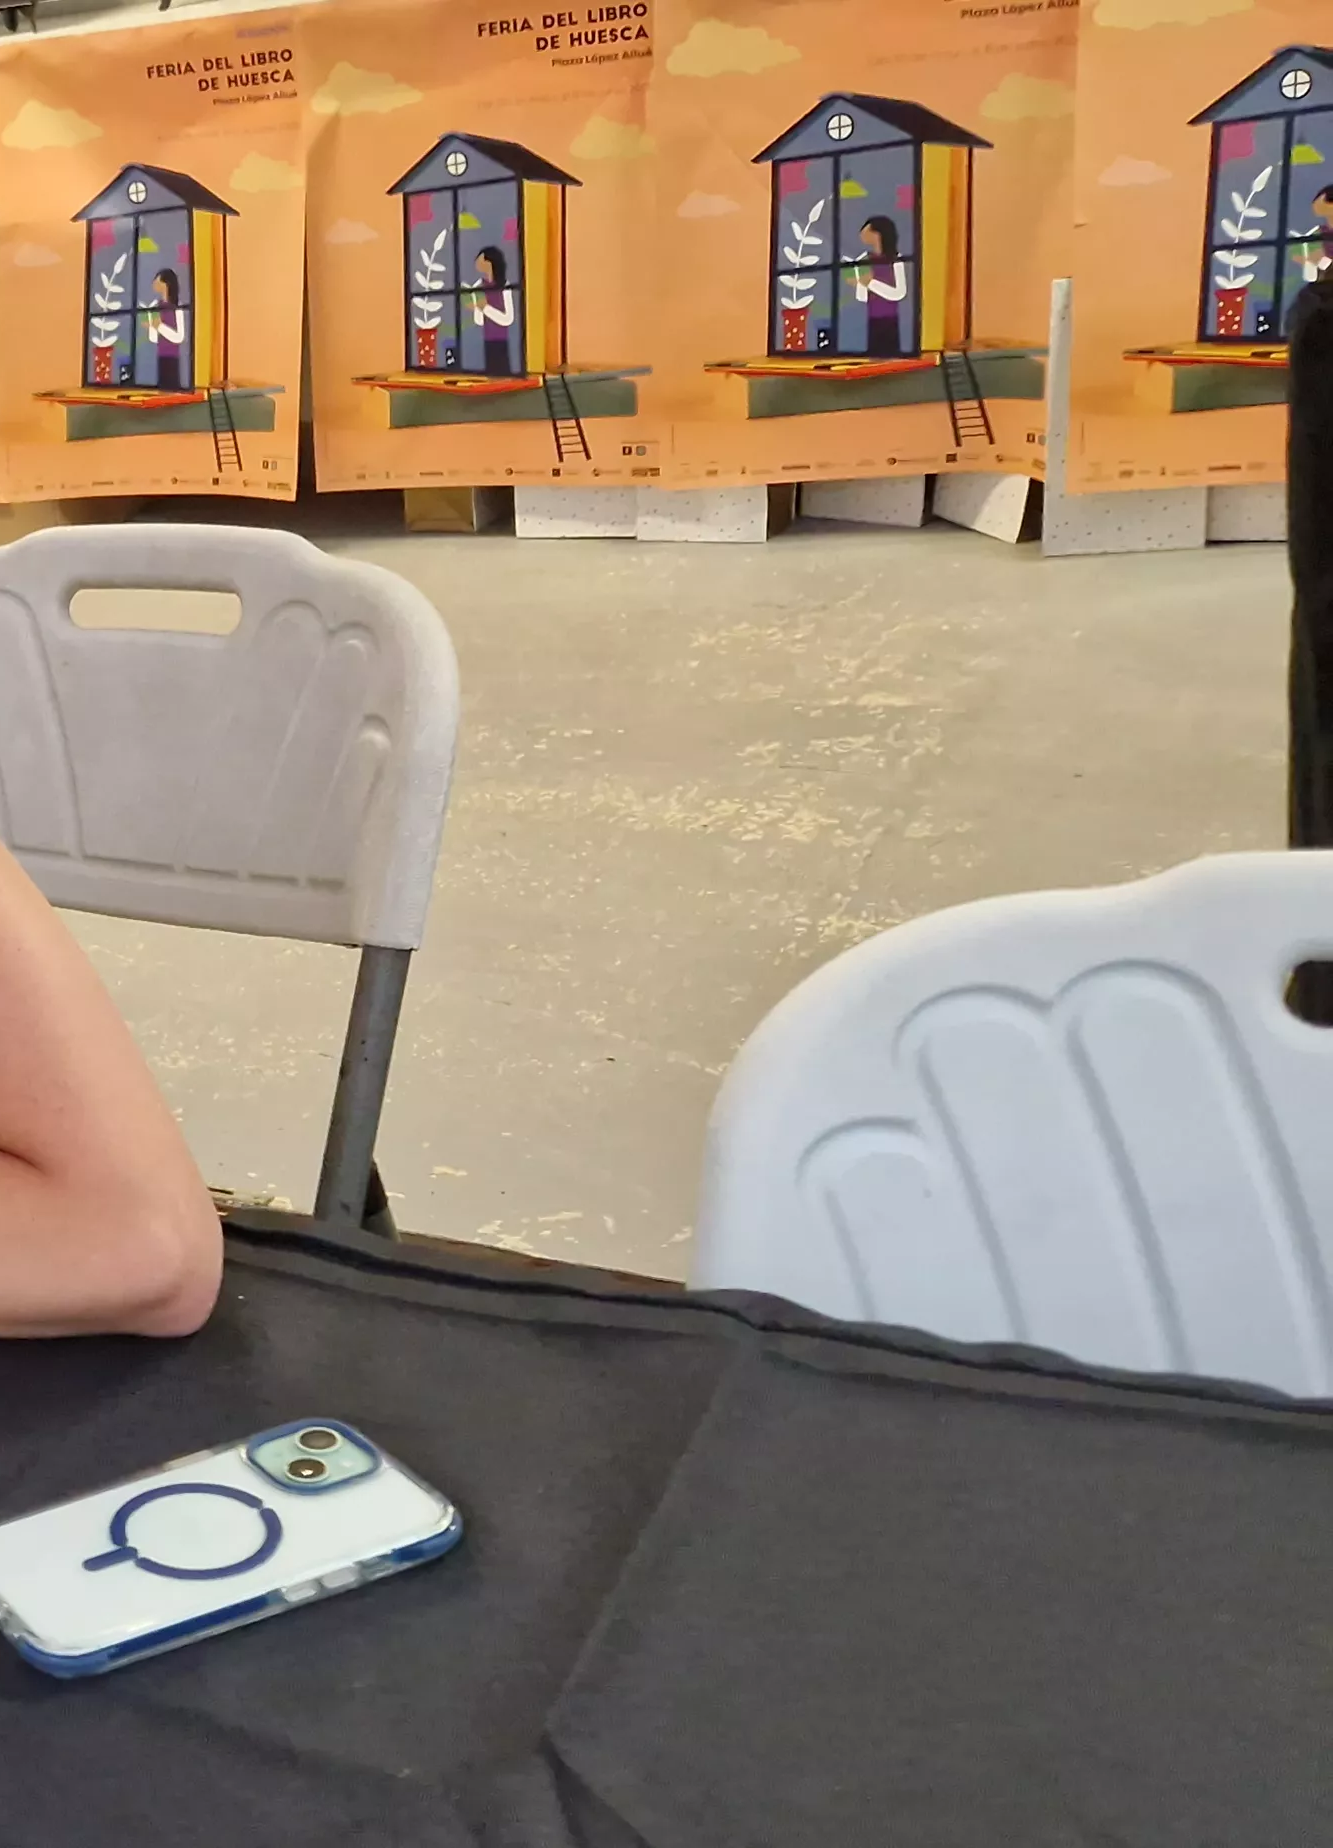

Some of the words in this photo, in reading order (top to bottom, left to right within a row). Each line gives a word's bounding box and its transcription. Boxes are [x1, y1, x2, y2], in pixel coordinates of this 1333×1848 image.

[477, 17, 534, 38] FERIA
[542, 11, 578, 29] DEL
[587, 2, 648, 24] LIBRO
[960, 8, 998, 19] Plaza
[1002, 3, 1043, 14] López
[535, 35, 560, 52] DE
[569, 24, 649, 48] HUESCA
[146, 61, 195, 79] FERIA
[202, 56, 233, 72] DEL
[241, 48, 293, 68] LIBRO
[551, 56, 584, 67] Plaza
[585, 51, 619, 65] López
[198, 77, 219, 92] DE
[227, 69, 295, 89] HUESCA
